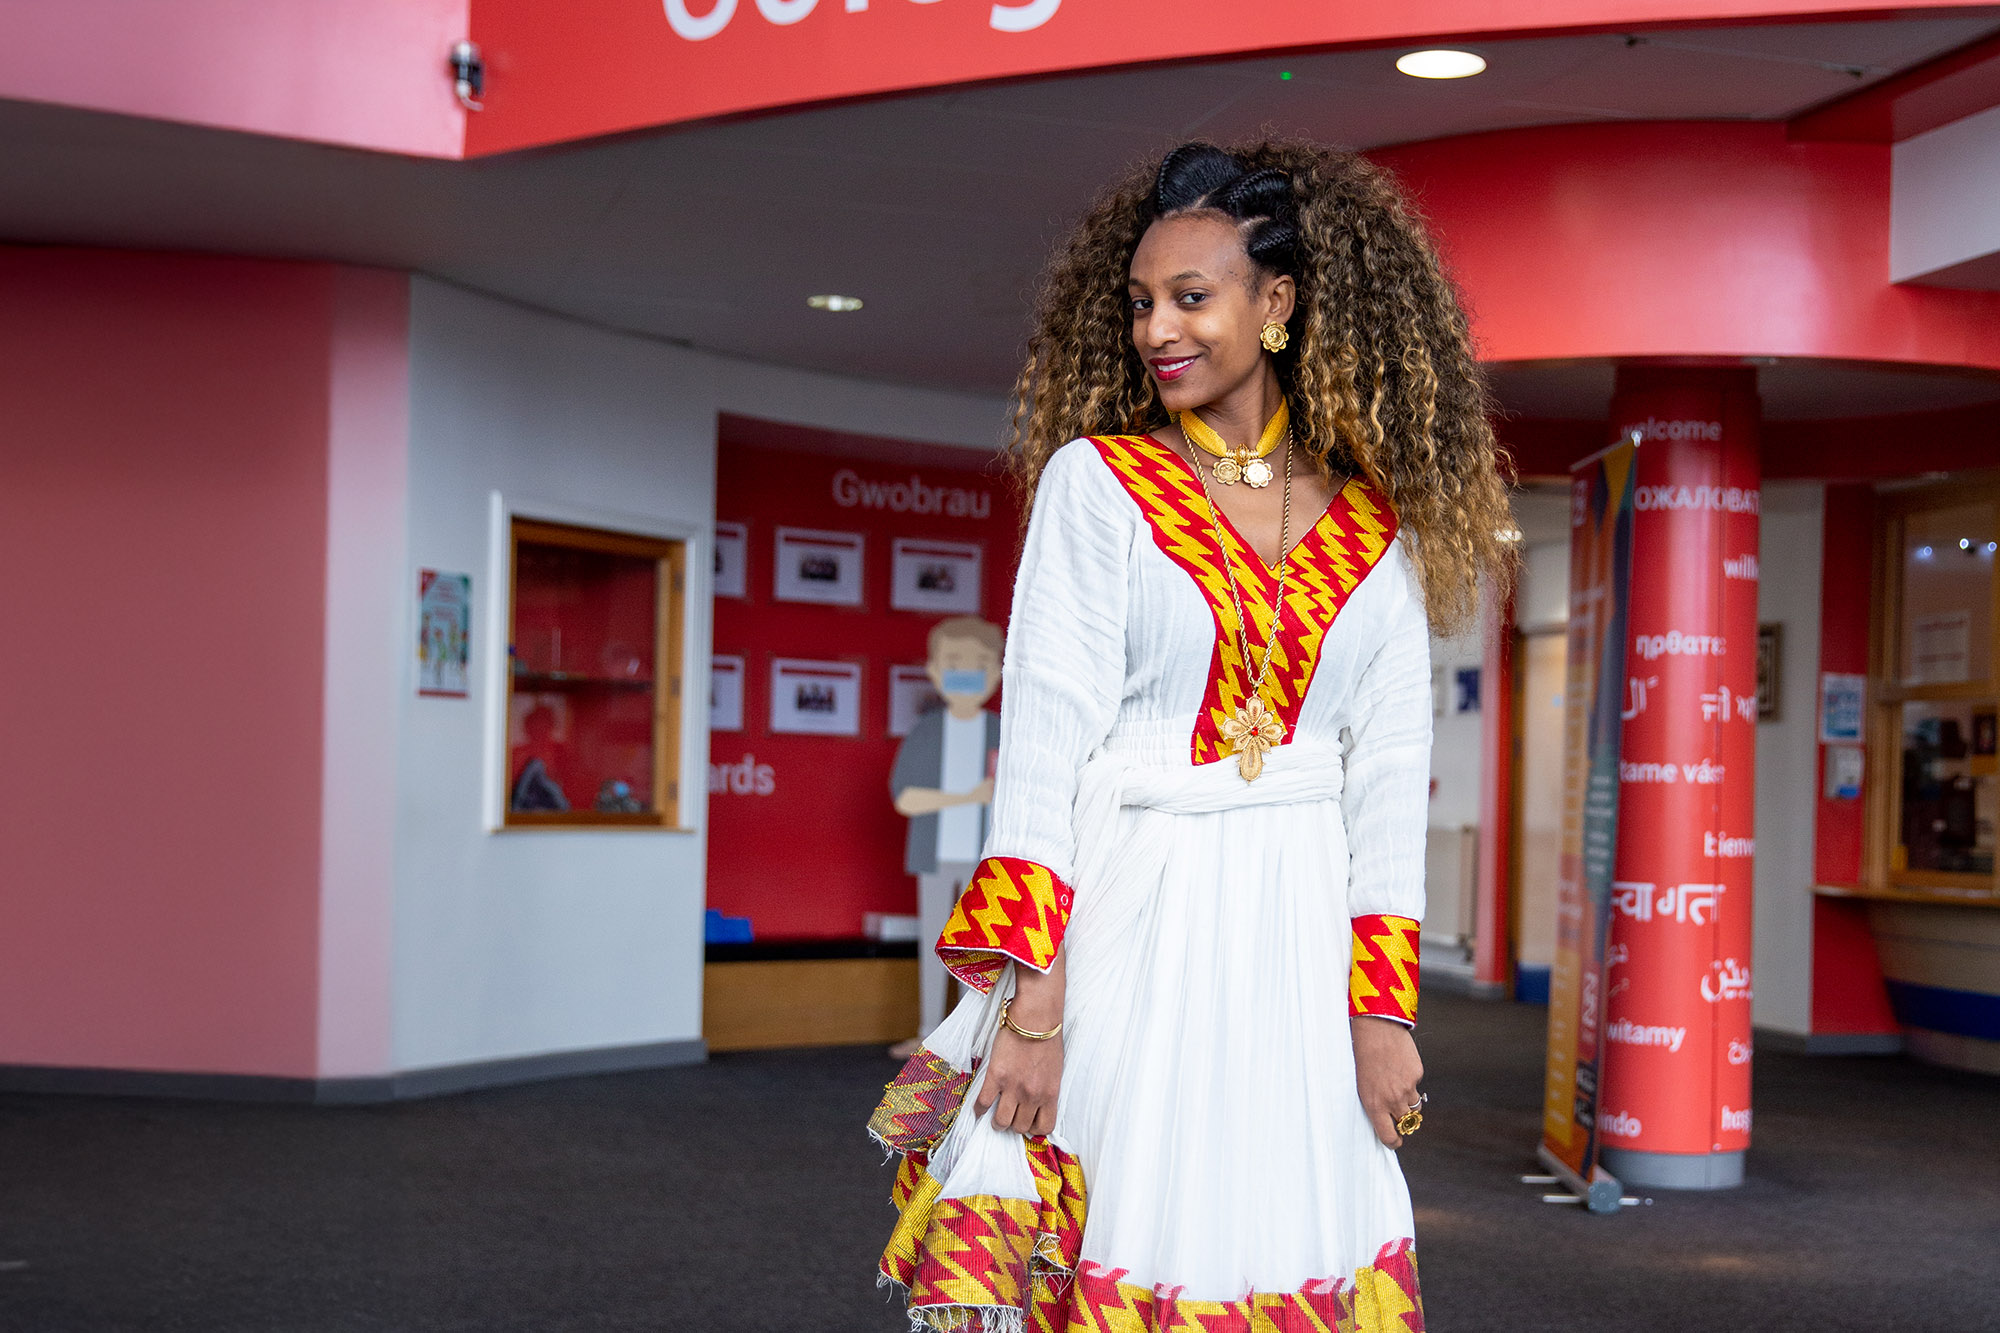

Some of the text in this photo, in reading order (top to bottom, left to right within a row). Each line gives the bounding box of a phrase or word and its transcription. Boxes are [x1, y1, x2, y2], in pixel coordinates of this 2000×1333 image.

[1621, 417, 1722, 441] welcome
[832, 469, 991, 518] Gwobrau
[1607, 1018, 1686, 1053] witamy
